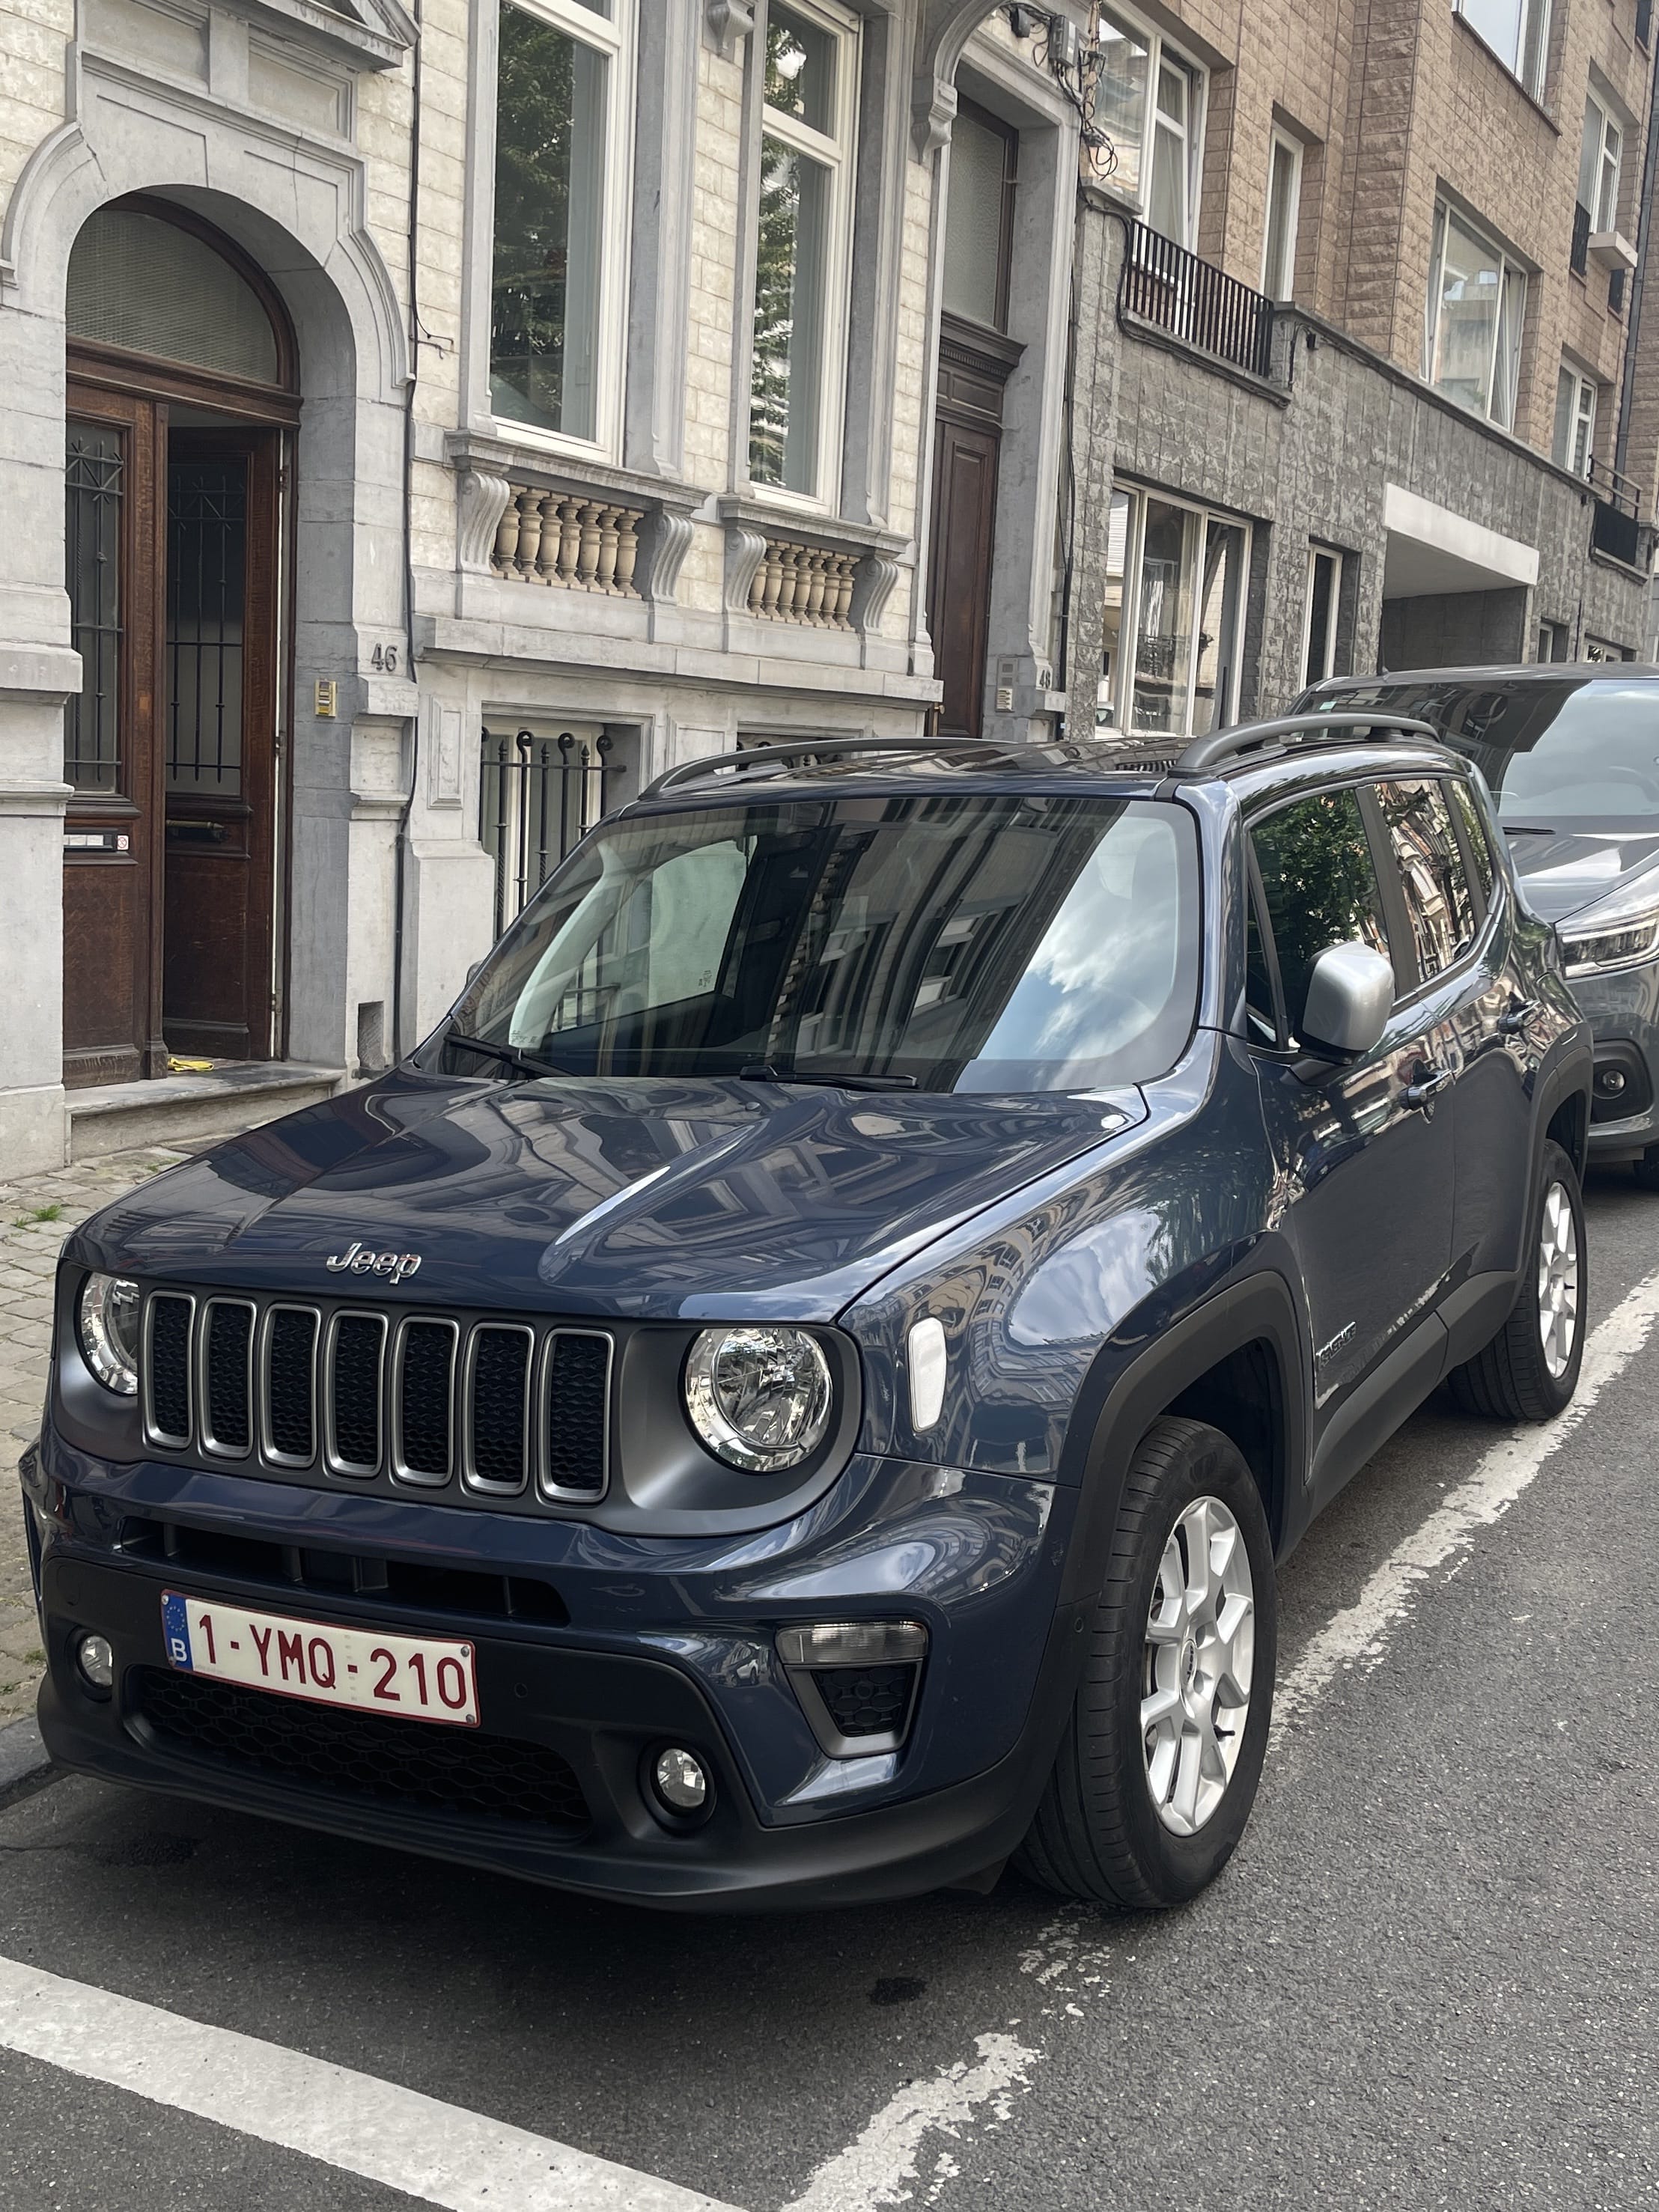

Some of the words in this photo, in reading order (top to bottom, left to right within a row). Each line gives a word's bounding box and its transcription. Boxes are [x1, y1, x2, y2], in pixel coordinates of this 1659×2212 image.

[371, 643, 398, 671] 46
[1039, 669, 1051, 689] 48
[326, 1243, 421, 1285] Jeep
[171, 1637, 187, 1662] B
[199, 1614, 466, 1709] 1-YMQ-210
